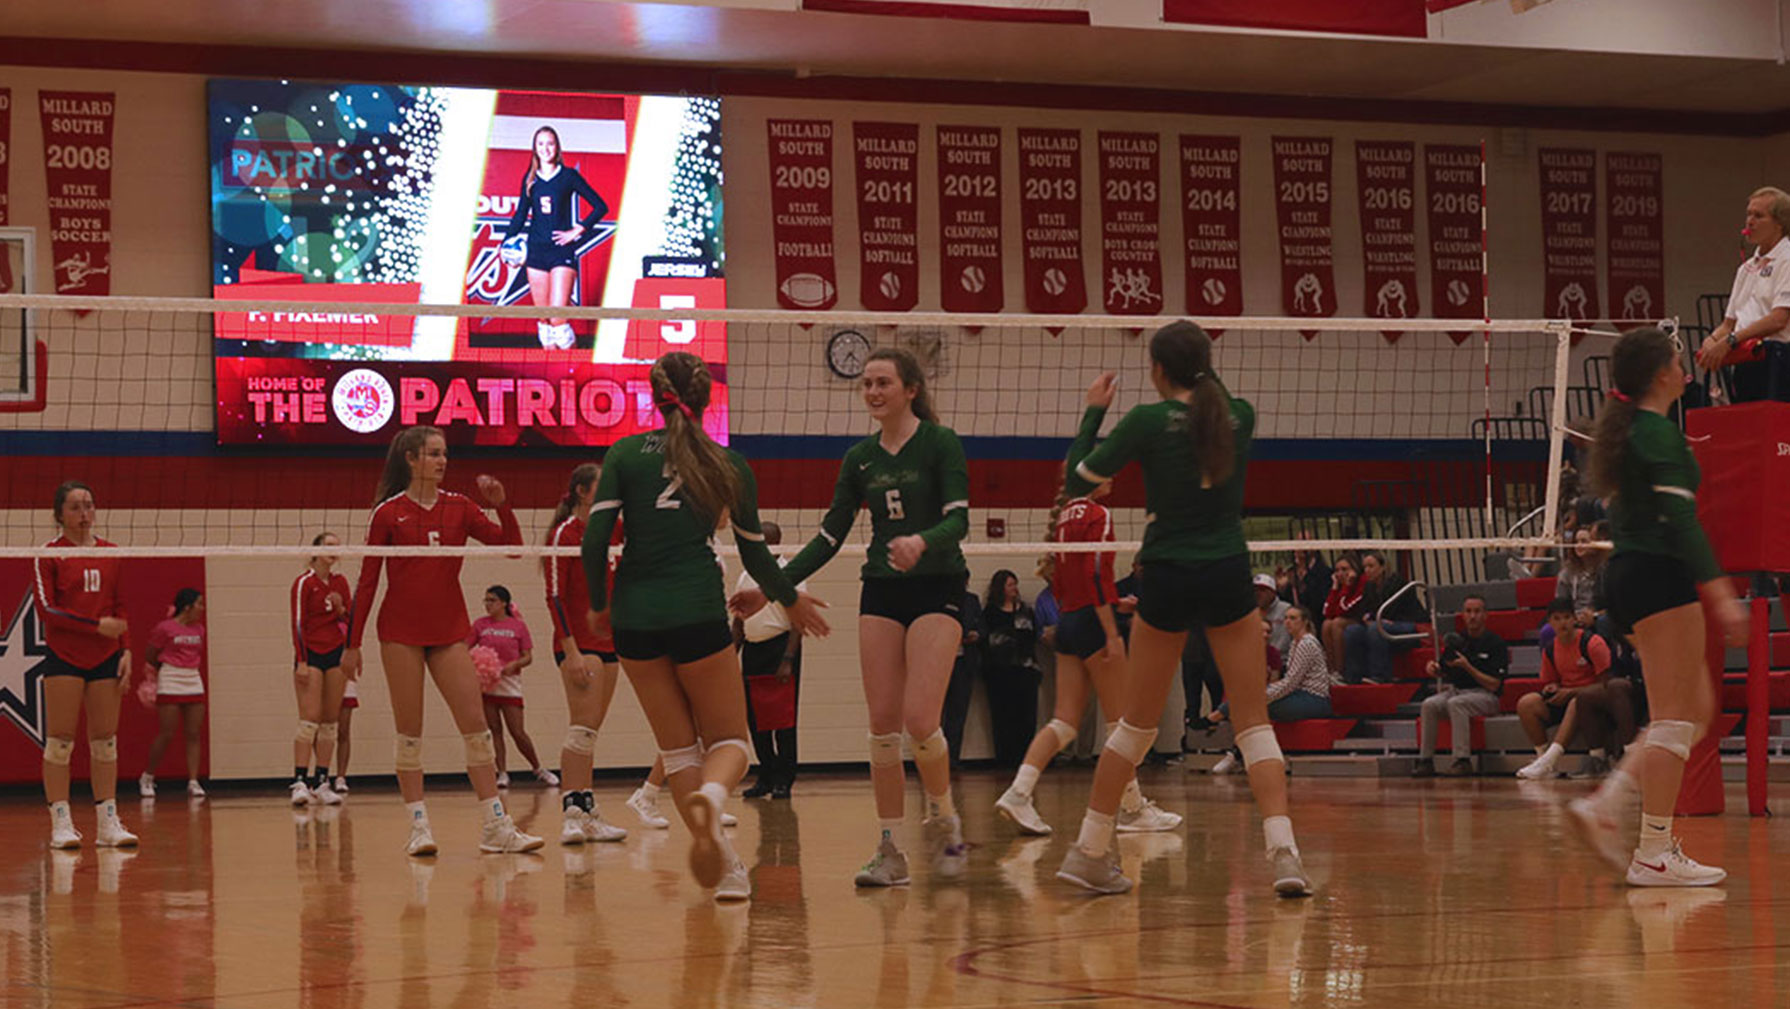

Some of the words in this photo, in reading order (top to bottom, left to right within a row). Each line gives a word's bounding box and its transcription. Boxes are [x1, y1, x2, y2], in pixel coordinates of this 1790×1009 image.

[43, 99, 112, 115] MILLARD
[52, 119, 104, 134] SOUTH
[771, 123, 831, 138] MILLARD
[857, 138, 916, 154] MILLARD
[940, 132, 998, 148] MILLARD
[1021, 137, 1078, 151] MILLARD
[1101, 139, 1157, 154] MILLARD
[779, 142, 824, 155] SOUTH
[1275, 141, 1329, 155] MILLARD
[48, 146, 110, 169] 2008
[948, 151, 991, 165] SOUTH
[1029, 154, 1071, 168] SOUTH
[1183, 148, 1238, 163] MILLARD
[1359, 149, 1412, 163] MILLARD
[1428, 152, 1480, 167] MILLARD
[865, 156, 909, 171] SOUTH
[1109, 156, 1150, 170] SOUTH
[1283, 159, 1323, 172] SOUTH
[776, 166, 831, 189] 2009
[1190, 165, 1232, 179] SOUTH
[1367, 166, 1406, 179] SOUTH
[1435, 170, 1474, 183] SOUTH
[62, 185, 97, 196] STATE
[864, 181, 912, 203] 2011
[945, 175, 996, 197] 2012
[1025, 178, 1077, 200] 2013
[1106, 180, 1156, 201] 2013
[1281, 182, 1329, 203] 2015
[540, 197, 551, 214] 5
[1188, 189, 1236, 211] 2014
[1365, 188, 1412, 210] 2016
[1433, 193, 1479, 214] 2016
[1547, 192, 1592, 214] 2017
[788, 203, 818, 213] STATE
[61, 218, 101, 229] BOYS
[874, 217, 902, 230] STATE
[956, 211, 985, 223] STATE
[1038, 214, 1066, 226] STATE
[1117, 212, 1144, 222] STATE
[1291, 212, 1318, 223] STATE
[1375, 218, 1402, 229] STATE
[945, 226, 998, 239] CHAMPIONS
[1106, 223, 1157, 233] CHAMPIONS
[1198, 224, 1226, 236] STATE
[1443, 227, 1470, 239] STATE
[52, 230, 111, 242] SOCCER
[863, 232, 915, 246] CHAMPIONS
[947, 244, 998, 257] SOFTBALL
[1105, 239, 1128, 250] BOYS
[865, 250, 914, 265] SOFTBALL
[1030, 247, 1078, 259] SOFTBALL
[1111, 251, 1154, 261] COUNTRY
[1191, 256, 1238, 269] SOFTBALL
[648, 263, 706, 277] JERSEY
[660, 295, 697, 344] 5
[248, 378, 298, 391] HOME
[302, 379, 325, 391] OF
[248, 392, 327, 423] THE
[655, 463, 682, 509] 2
[885, 489, 905, 520] 6
[83, 569, 101, 592] 10
